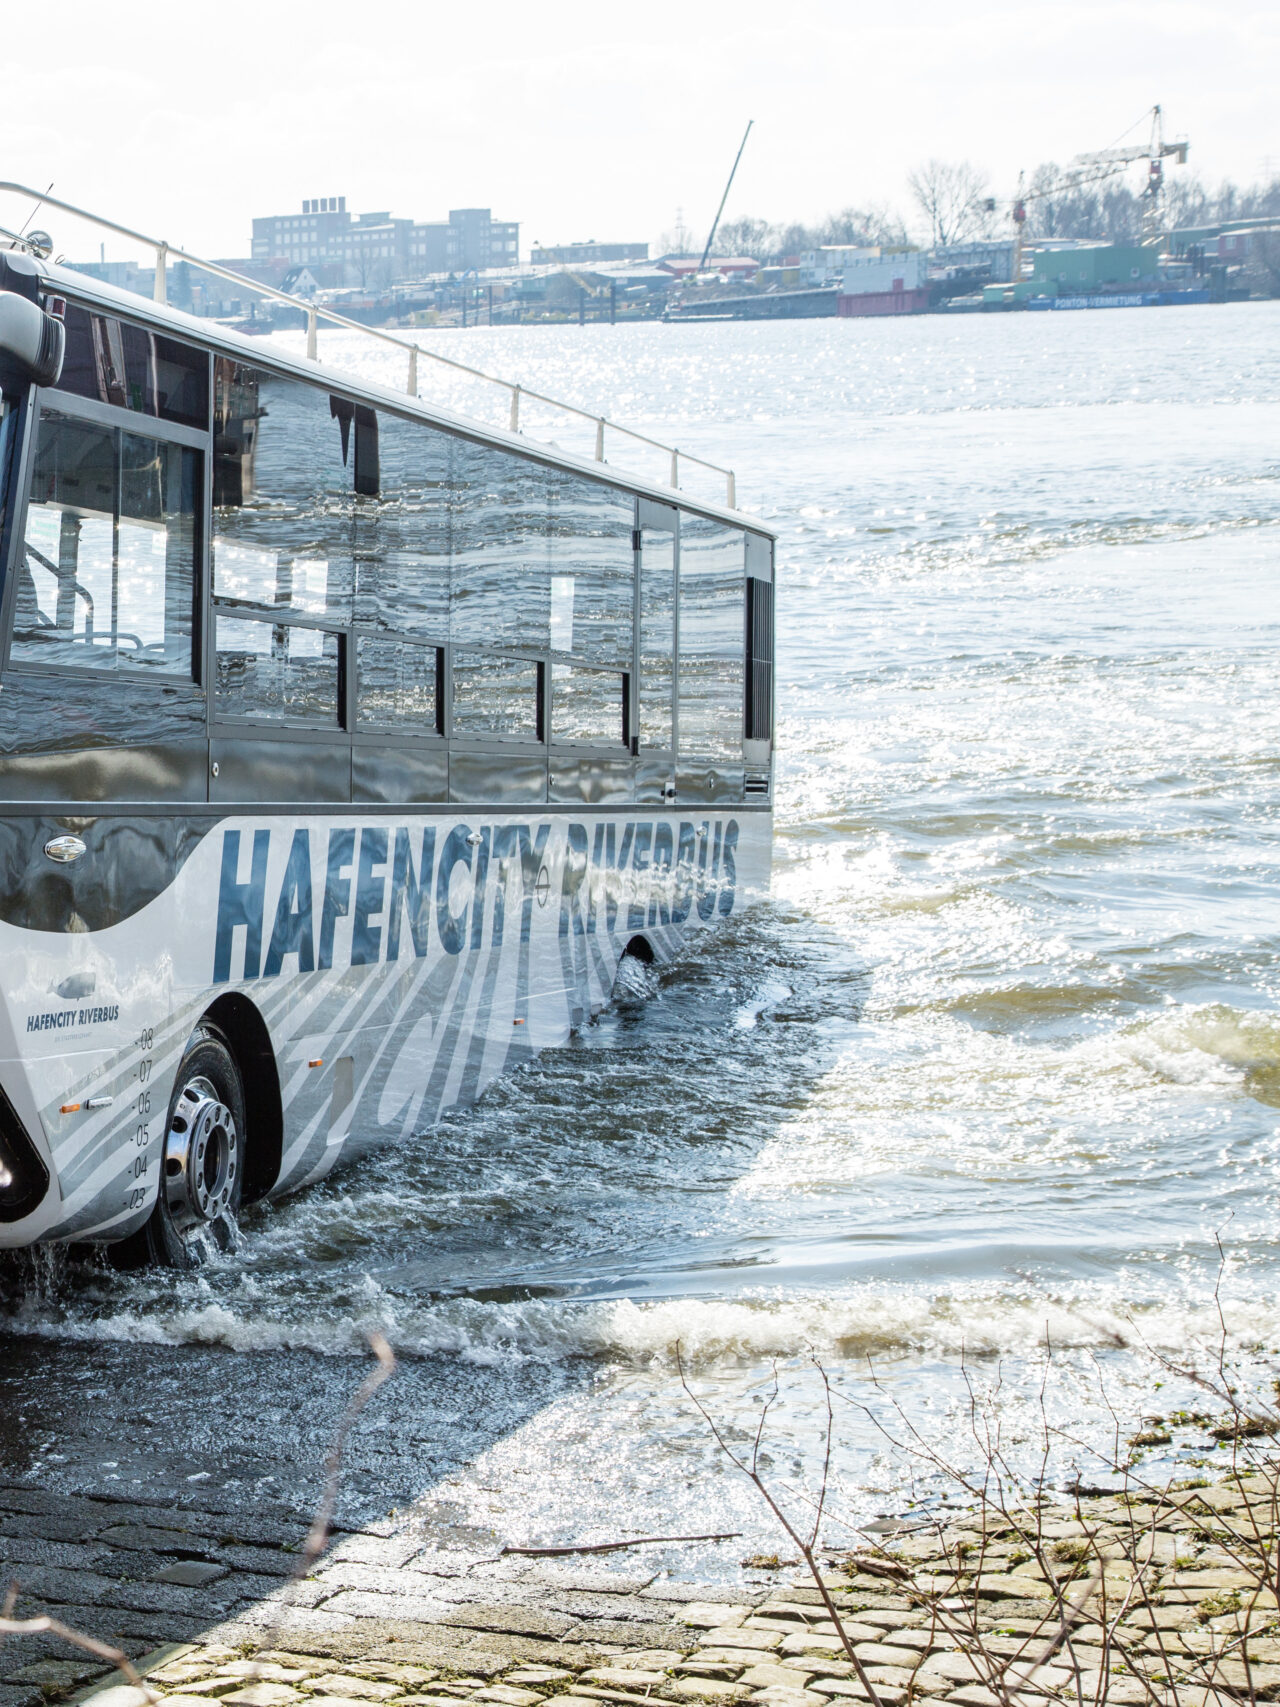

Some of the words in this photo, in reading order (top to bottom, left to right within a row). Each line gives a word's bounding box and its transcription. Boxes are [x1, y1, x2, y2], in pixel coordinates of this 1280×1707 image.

[213, 823, 551, 984] HAFENCITY
[557, 818, 740, 938] RIVERBUS
[26, 1010, 78, 1033] HAFENCITY
[78, 1004, 119, 1026] RIVERBUS
